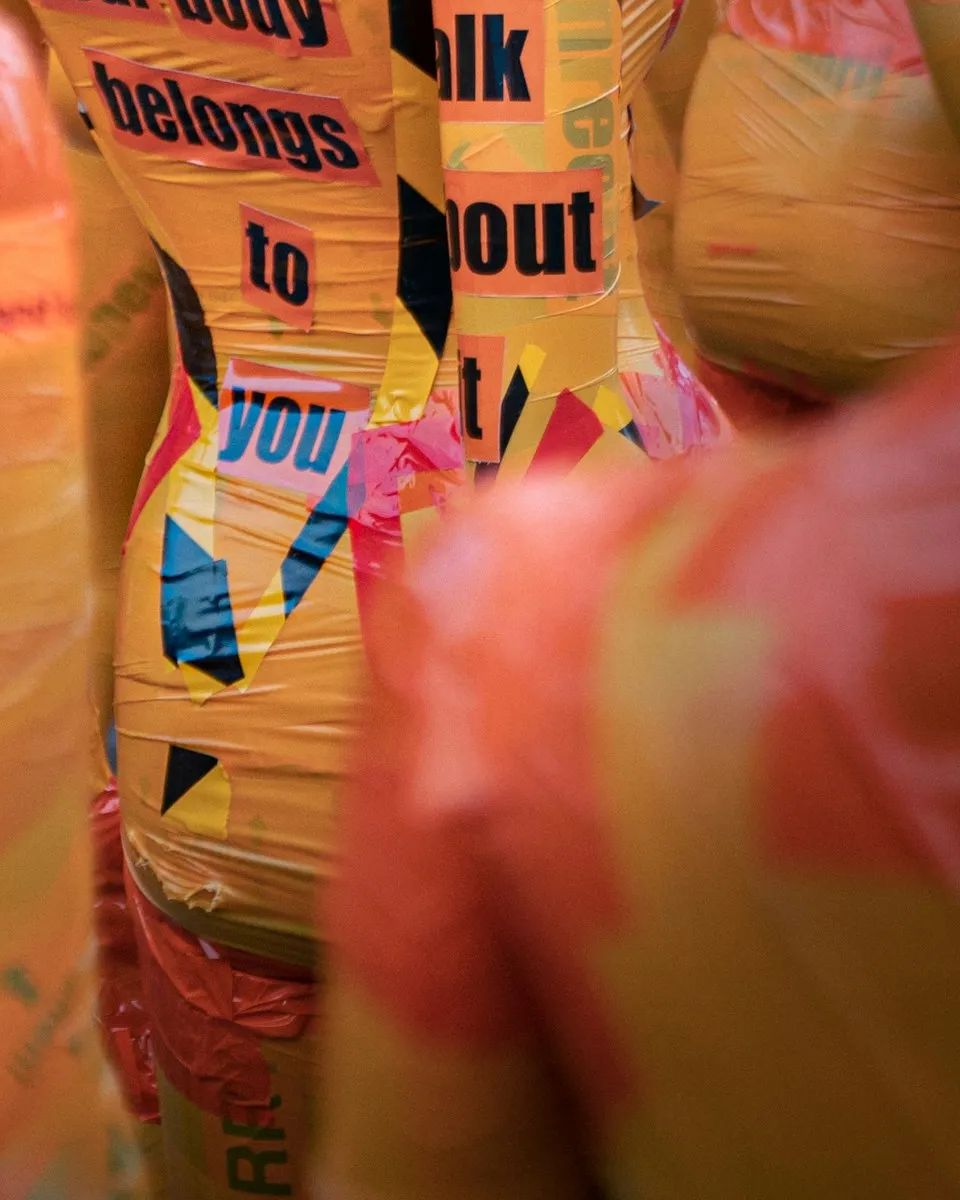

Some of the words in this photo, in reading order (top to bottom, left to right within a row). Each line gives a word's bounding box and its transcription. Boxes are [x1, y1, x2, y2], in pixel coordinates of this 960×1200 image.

[92, 60, 361, 173] belongs
[245, 220, 310, 307] to
[218, 385, 347, 476] you
[458, 356, 484, 441] t
